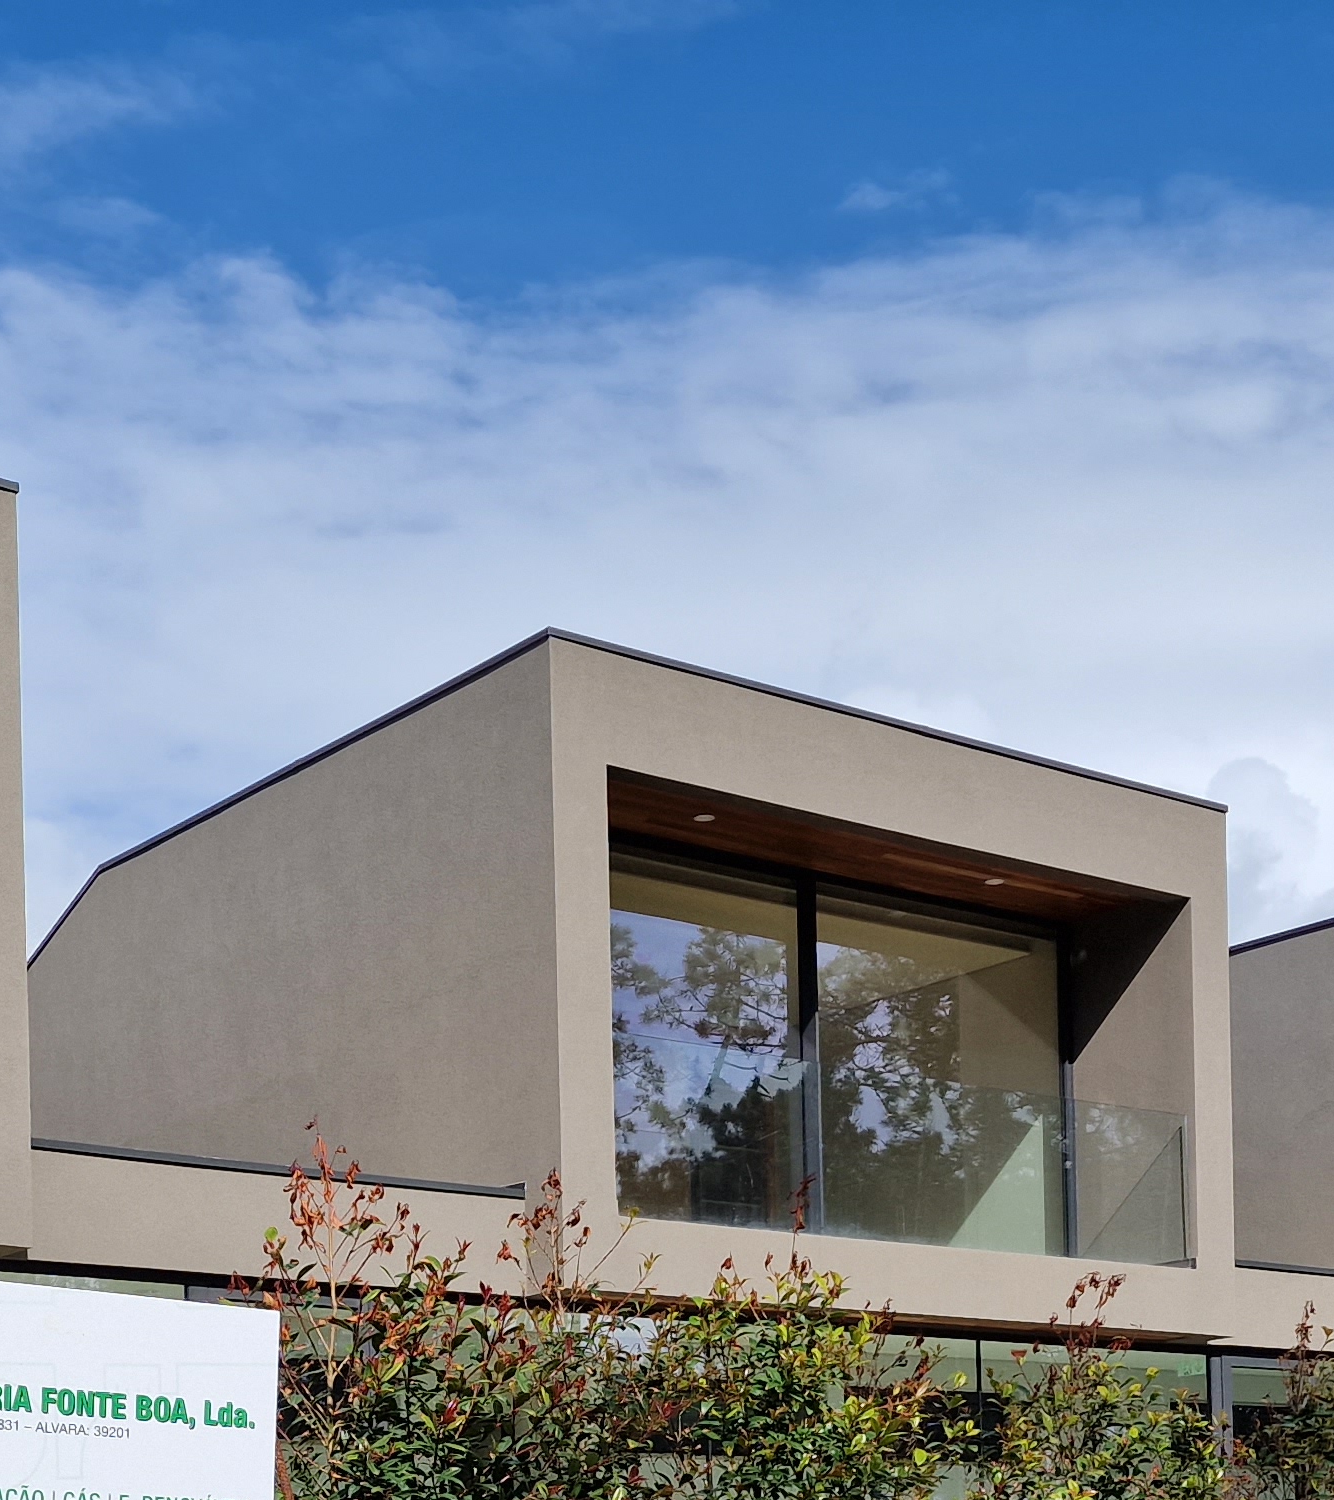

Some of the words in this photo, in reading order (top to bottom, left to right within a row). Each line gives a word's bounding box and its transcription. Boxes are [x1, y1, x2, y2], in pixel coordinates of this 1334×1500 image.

[41, 1387, 127, 1420] FONTE
[135, 1394, 195, 1429] BOA,
[204, 1400, 255, 1429] Lda.
[35, 1422, 90, 1436] ALVARA:
[94, 1426, 129, 1438] 39201
